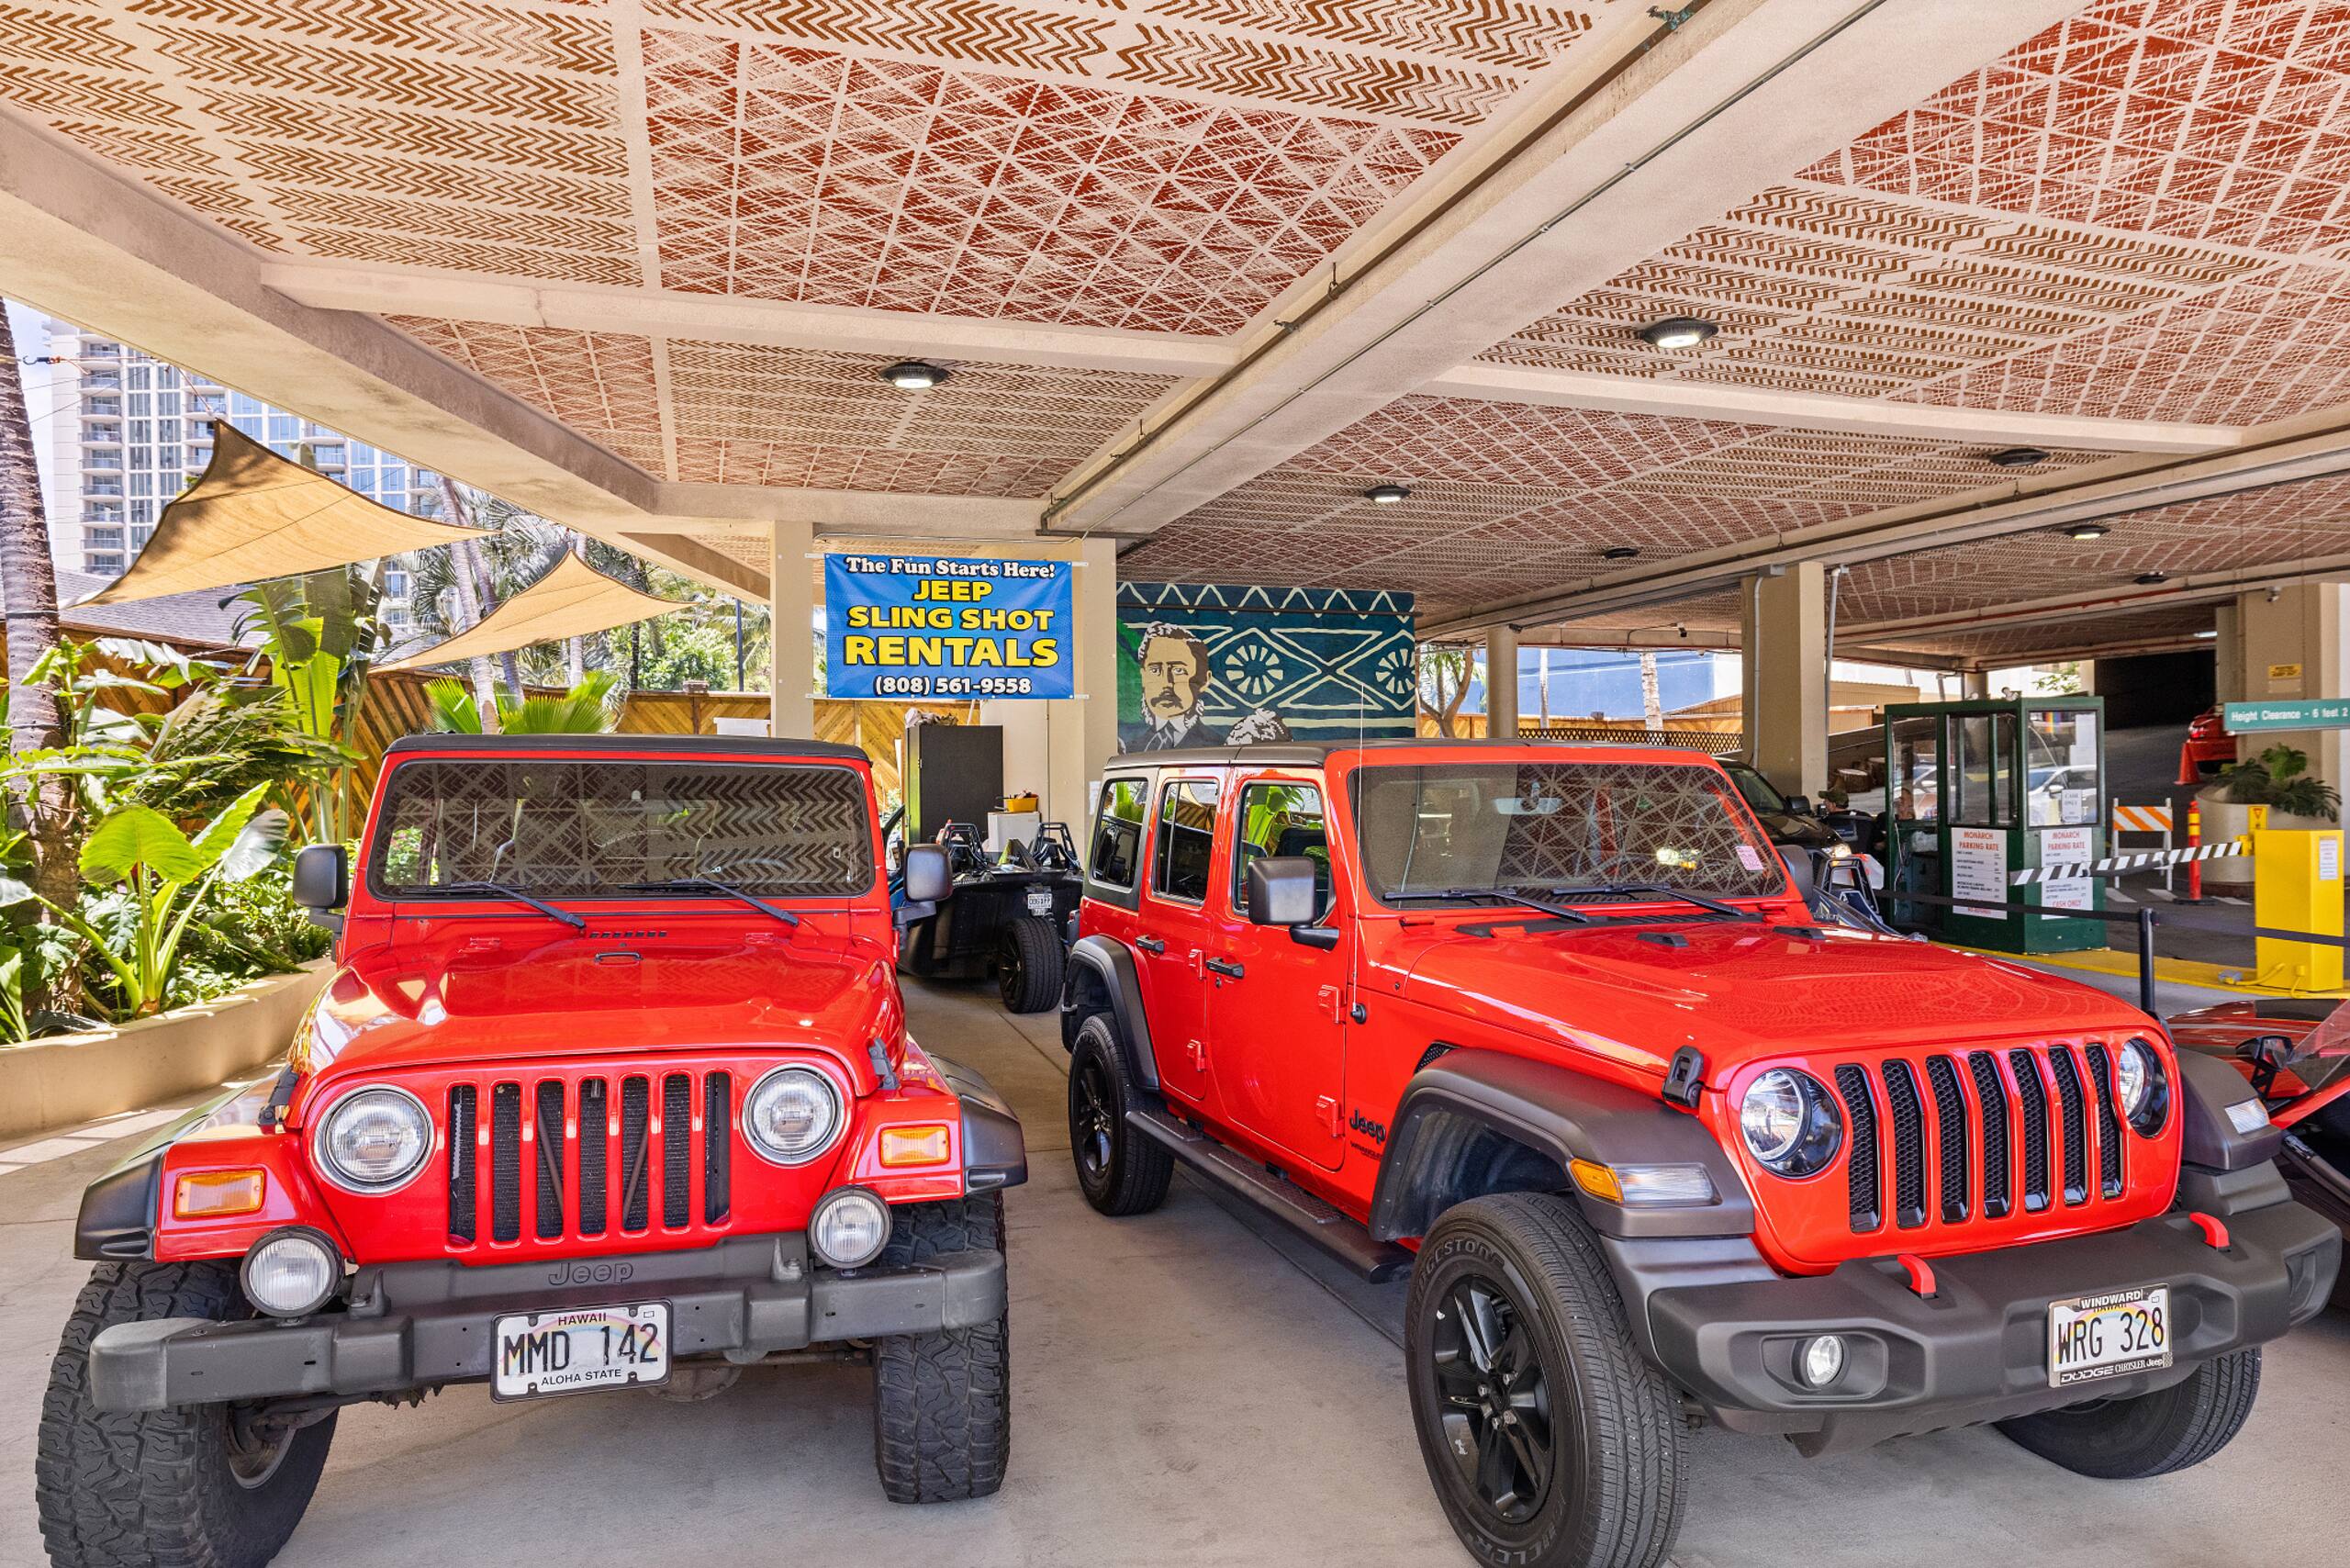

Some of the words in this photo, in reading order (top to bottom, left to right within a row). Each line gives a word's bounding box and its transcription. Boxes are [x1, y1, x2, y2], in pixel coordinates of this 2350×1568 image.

[845, 557, 885, 574] The
[890, 558, 931, 575] Fun
[935, 560, 999, 577] Starts
[1002, 561, 1056, 578] Here!
[913, 579, 993, 601] JEEP
[848, 606, 953, 629] SLING
[961, 609, 1054, 631] SHOT
[845, 635, 1059, 667] RENTALS
[875, 676, 931, 696] (808)
[935, 678, 1031, 695] 561-9558
[2232, 711, 2257, 722] Height
[2262, 710, 2301, 721] Clearance
[1964, 832, 1993, 840] MONARCH
[2052, 831, 2080, 839] MONARCH
[1959, 842, 1984, 850] PARKING
[1986, 843, 1998, 851] RATE
[1349, 1107, 1386, 1145] Jeep
[548, 1262, 633, 1285] Jeep
[2080, 1291, 2141, 1309] WINDWARD
[558, 1313, 607, 1327] HAWAII
[2058, 1317, 2102, 1364] WRG
[2120, 1307, 2164, 1352] 328
[504, 1330, 571, 1376] MMD
[600, 1323, 658, 1366] 142
[541, 1373, 582, 1386] ALOHA
[585, 1369, 621, 1381] STATE
[2060, 1366, 2114, 1383] DODGE
[2115, 1359, 2146, 1373] CHRYSLER
[2146, 1358, 2163, 1368] Jeep
